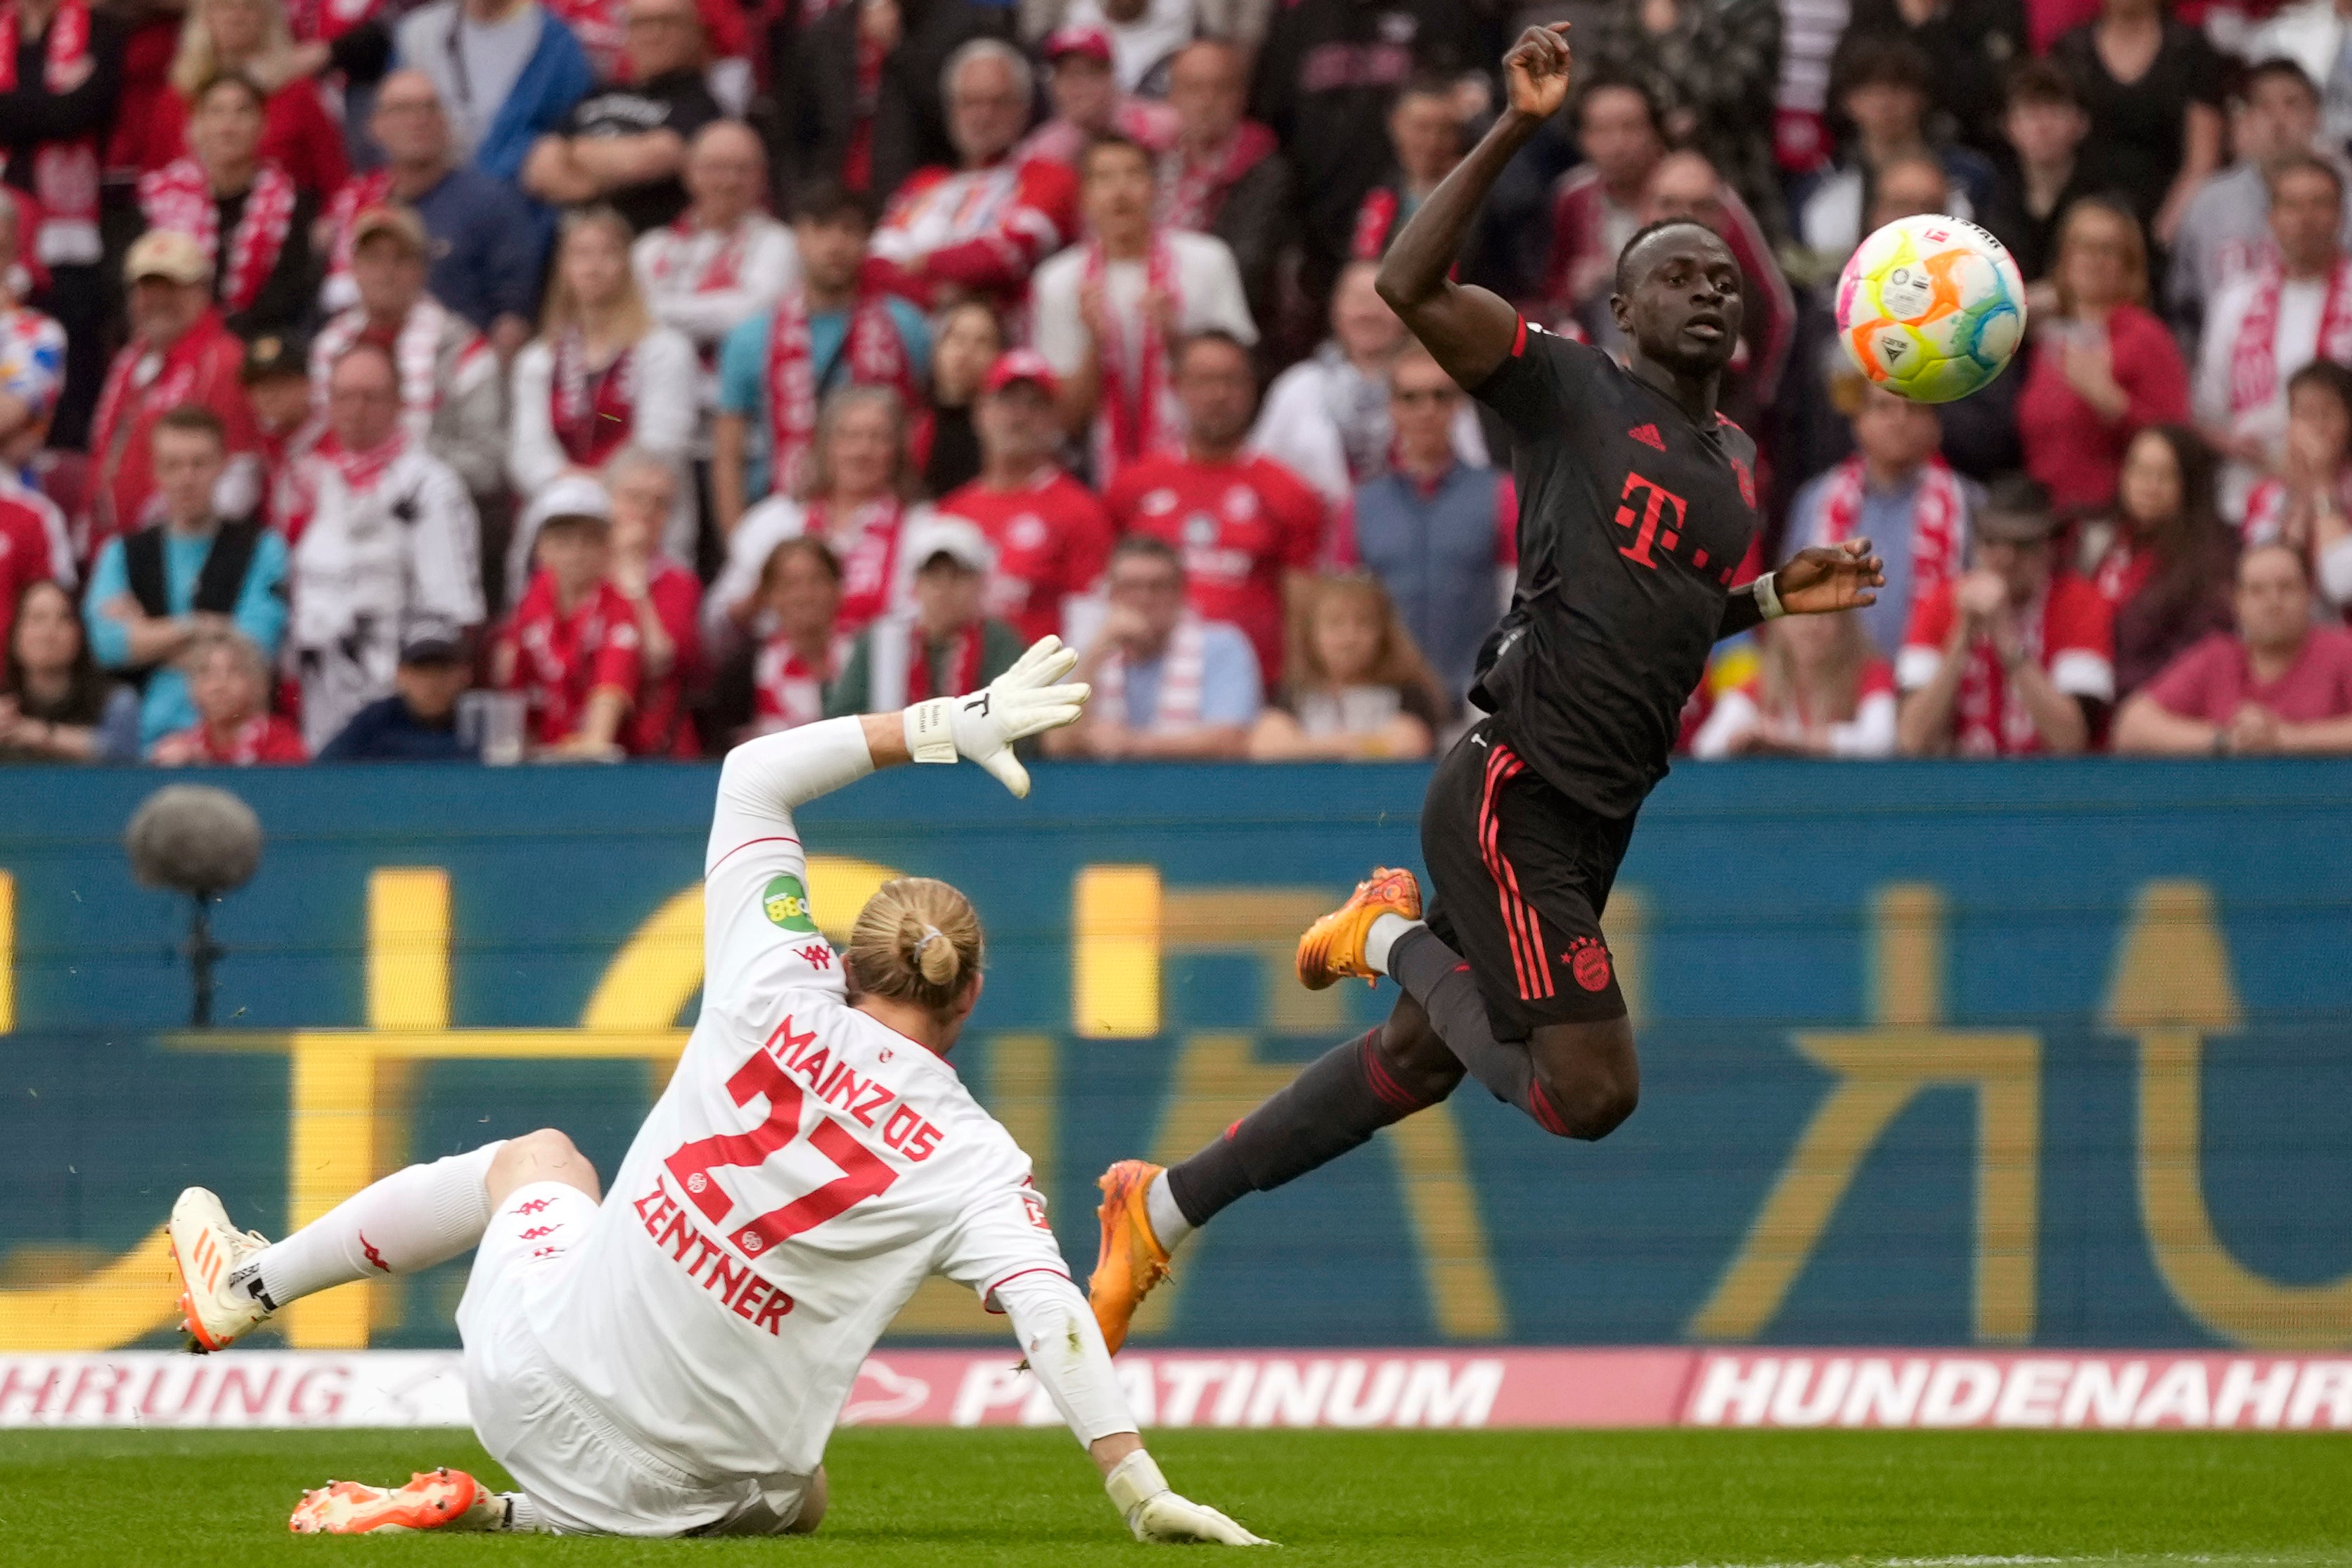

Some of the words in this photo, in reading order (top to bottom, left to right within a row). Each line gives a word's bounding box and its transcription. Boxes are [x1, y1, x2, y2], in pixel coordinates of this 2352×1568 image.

[932, 705, 941, 726] Robin
[663, 1047, 900, 1261] 27
[765, 1014, 897, 1129] MAINZ
[883, 1103, 944, 1163] 05
[633, 1174, 795, 1337] ZENTNER
[1695, 1358, 2352, 1429] HUNDENAHR
